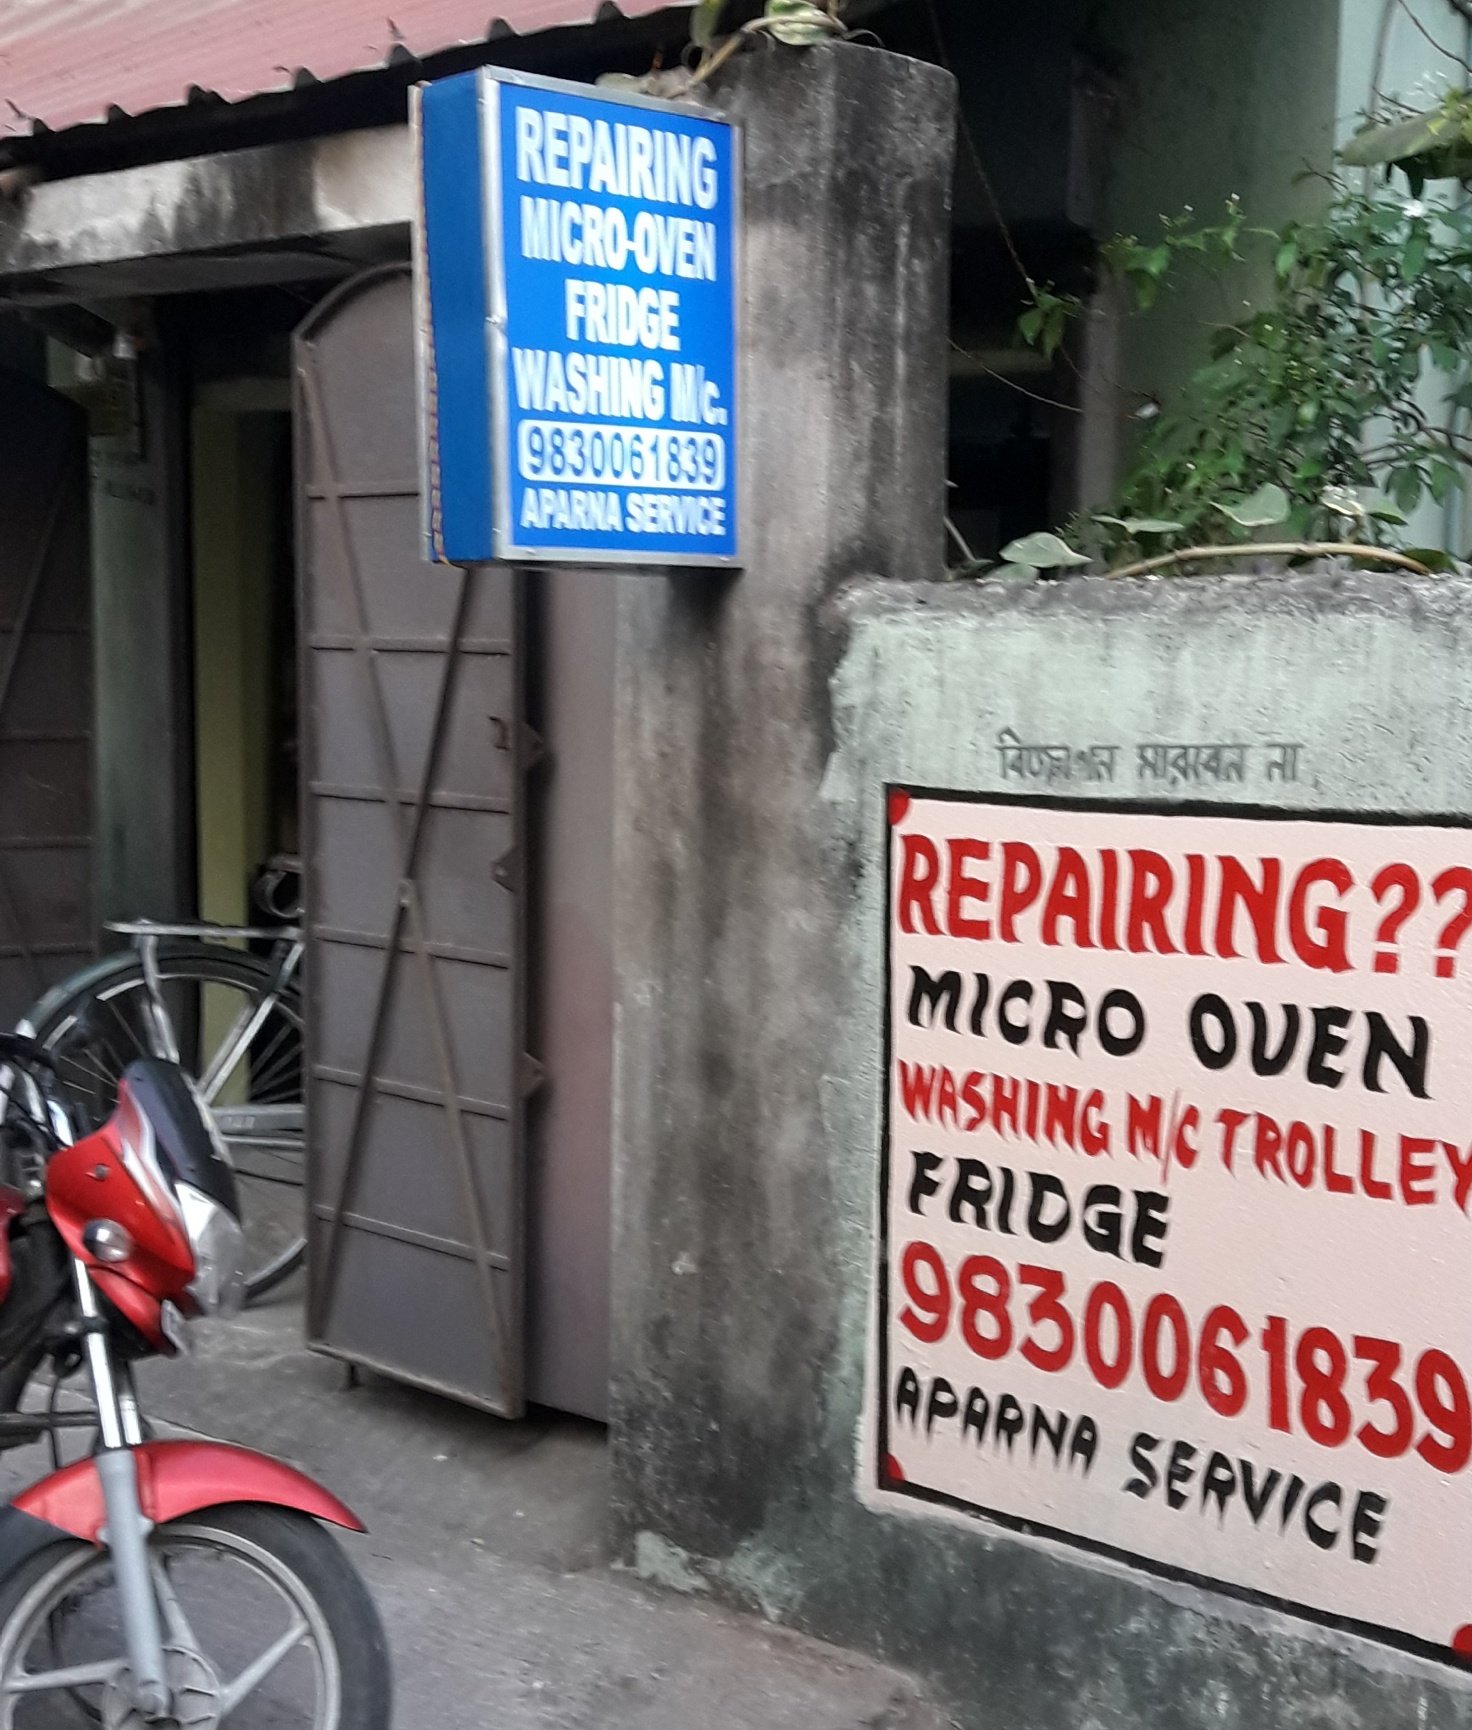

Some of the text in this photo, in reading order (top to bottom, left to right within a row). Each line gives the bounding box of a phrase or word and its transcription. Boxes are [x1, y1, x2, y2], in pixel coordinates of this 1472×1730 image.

[515, 106, 719, 210] REPAIRING
[519, 195, 718, 281] MICRO-OVEN
[565, 278, 682, 351] FRIDGE
[512, 347, 665, 422] WASHING
[528, 427, 719, 487] 9830061839
[520, 486, 727, 537] APARNA SERVICE
[1263, 742, 1304, 782] না
[907, 964, 1148, 1059] MICRO
[899, 1058, 1472, 1215] WASHING M/C TROLLEY
[907, 1150, 1171, 1268] FRIDGE
[899, 1240, 1472, 1475] 9830061839
[895, 1366, 1389, 1565] APARNA SERVICE
